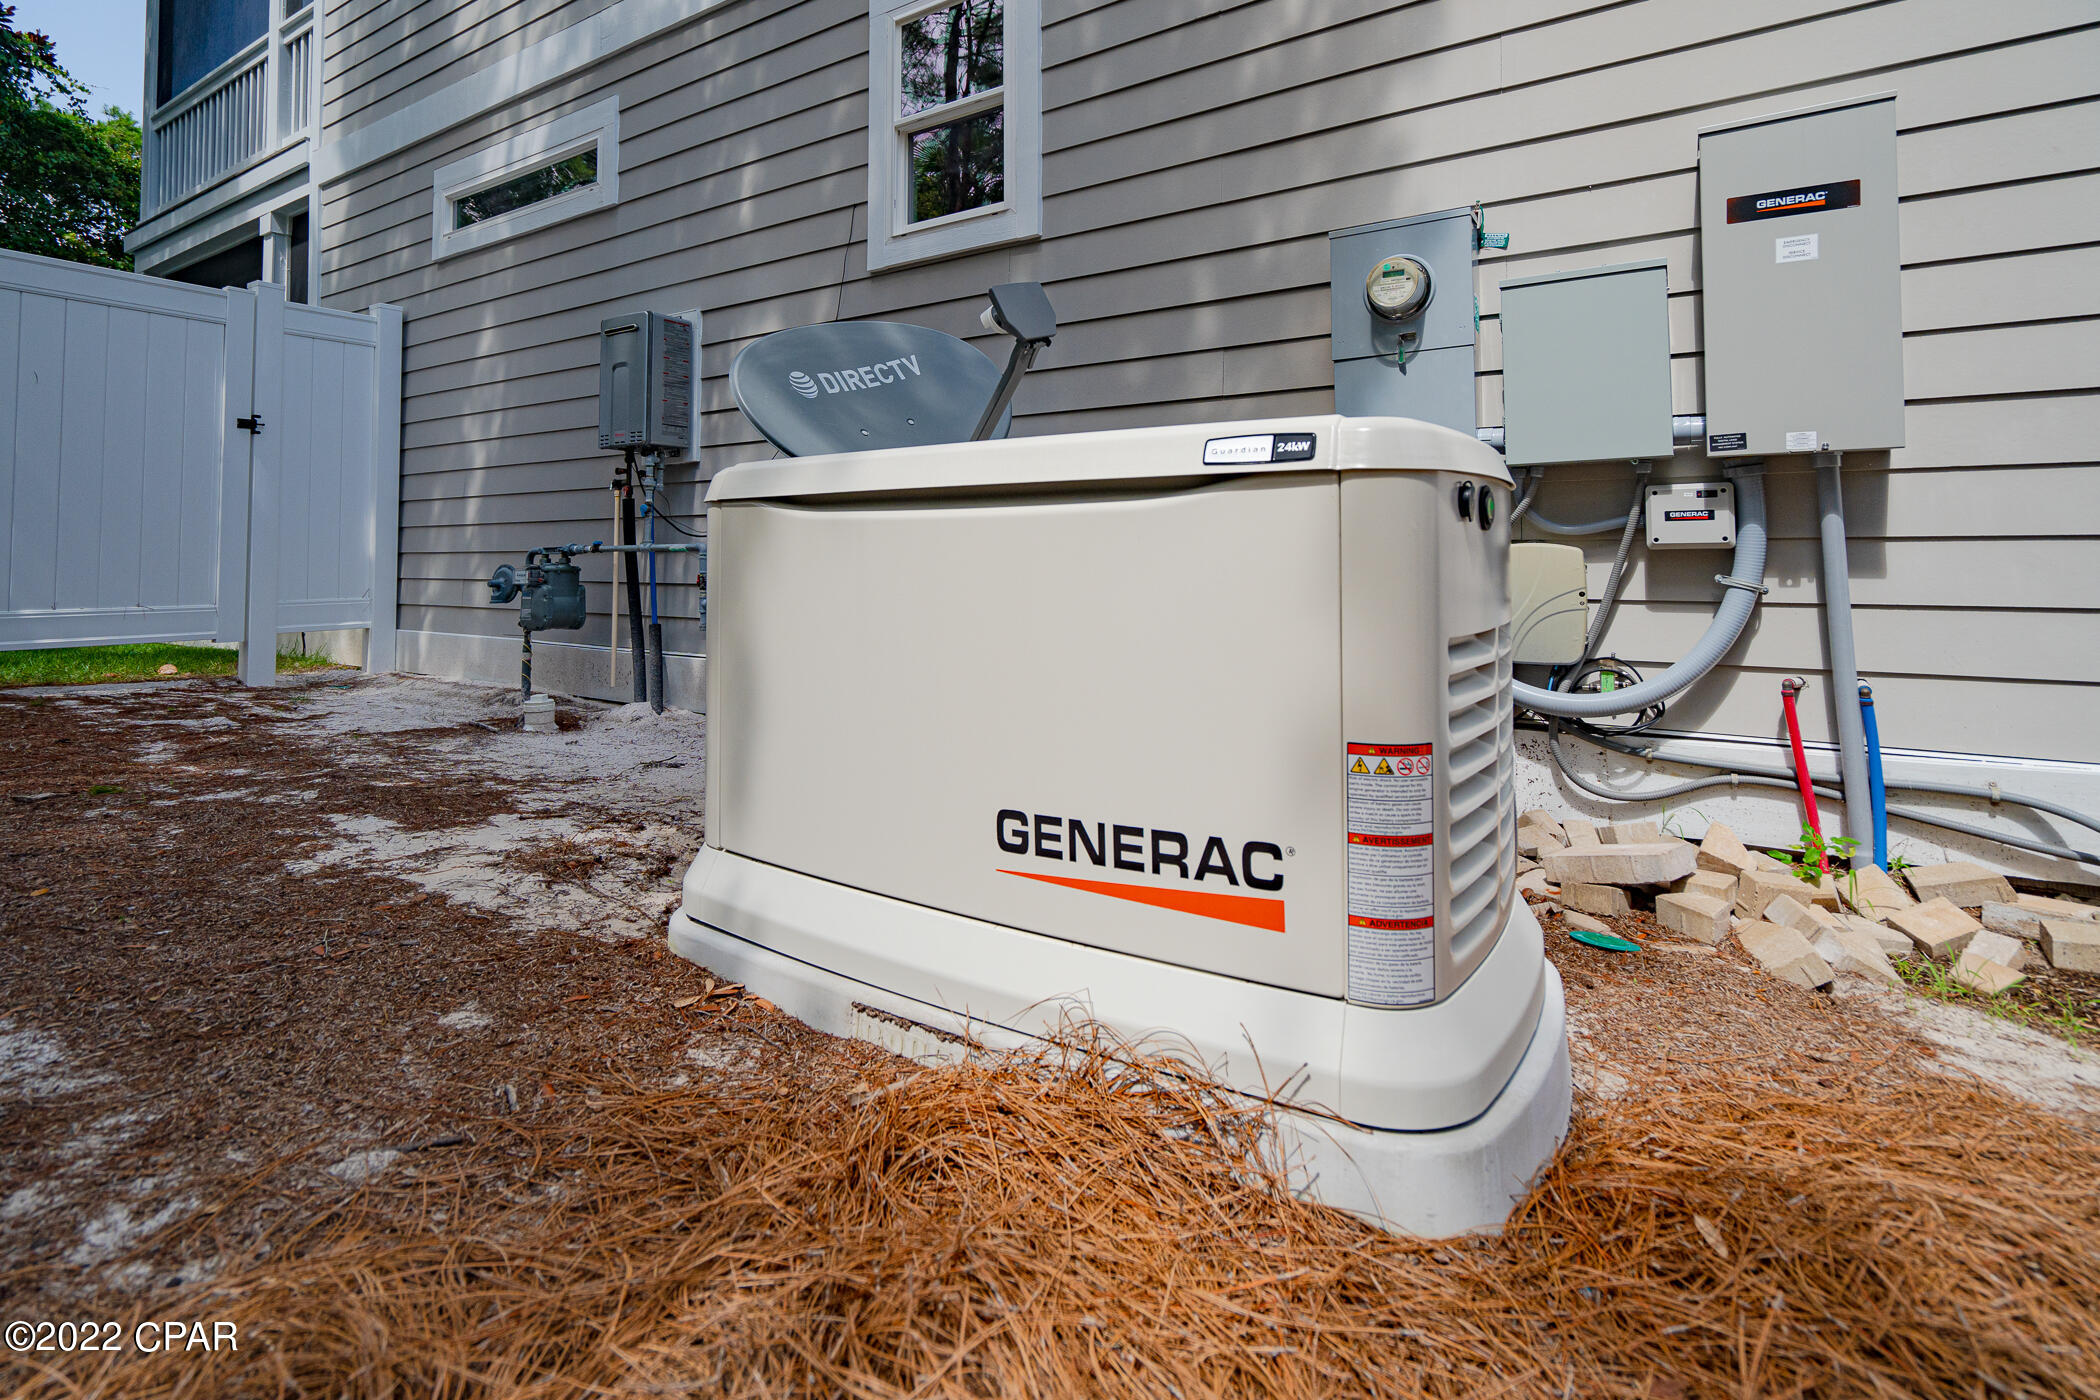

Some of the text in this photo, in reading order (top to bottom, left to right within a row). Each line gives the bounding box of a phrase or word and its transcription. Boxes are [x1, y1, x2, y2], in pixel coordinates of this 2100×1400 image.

[1756, 191, 1827, 209] GENERAC
[816, 354, 921, 394] DIRECTV
[1211, 441, 1310, 455] Guardian 24kW
[1378, 747, 1420, 755] WARNING
[1362, 835, 1431, 846] AVERTISSEMENT
[996, 808, 1285, 892] GENERAC
[1369, 919, 1428, 929] ADVERTENCIA
